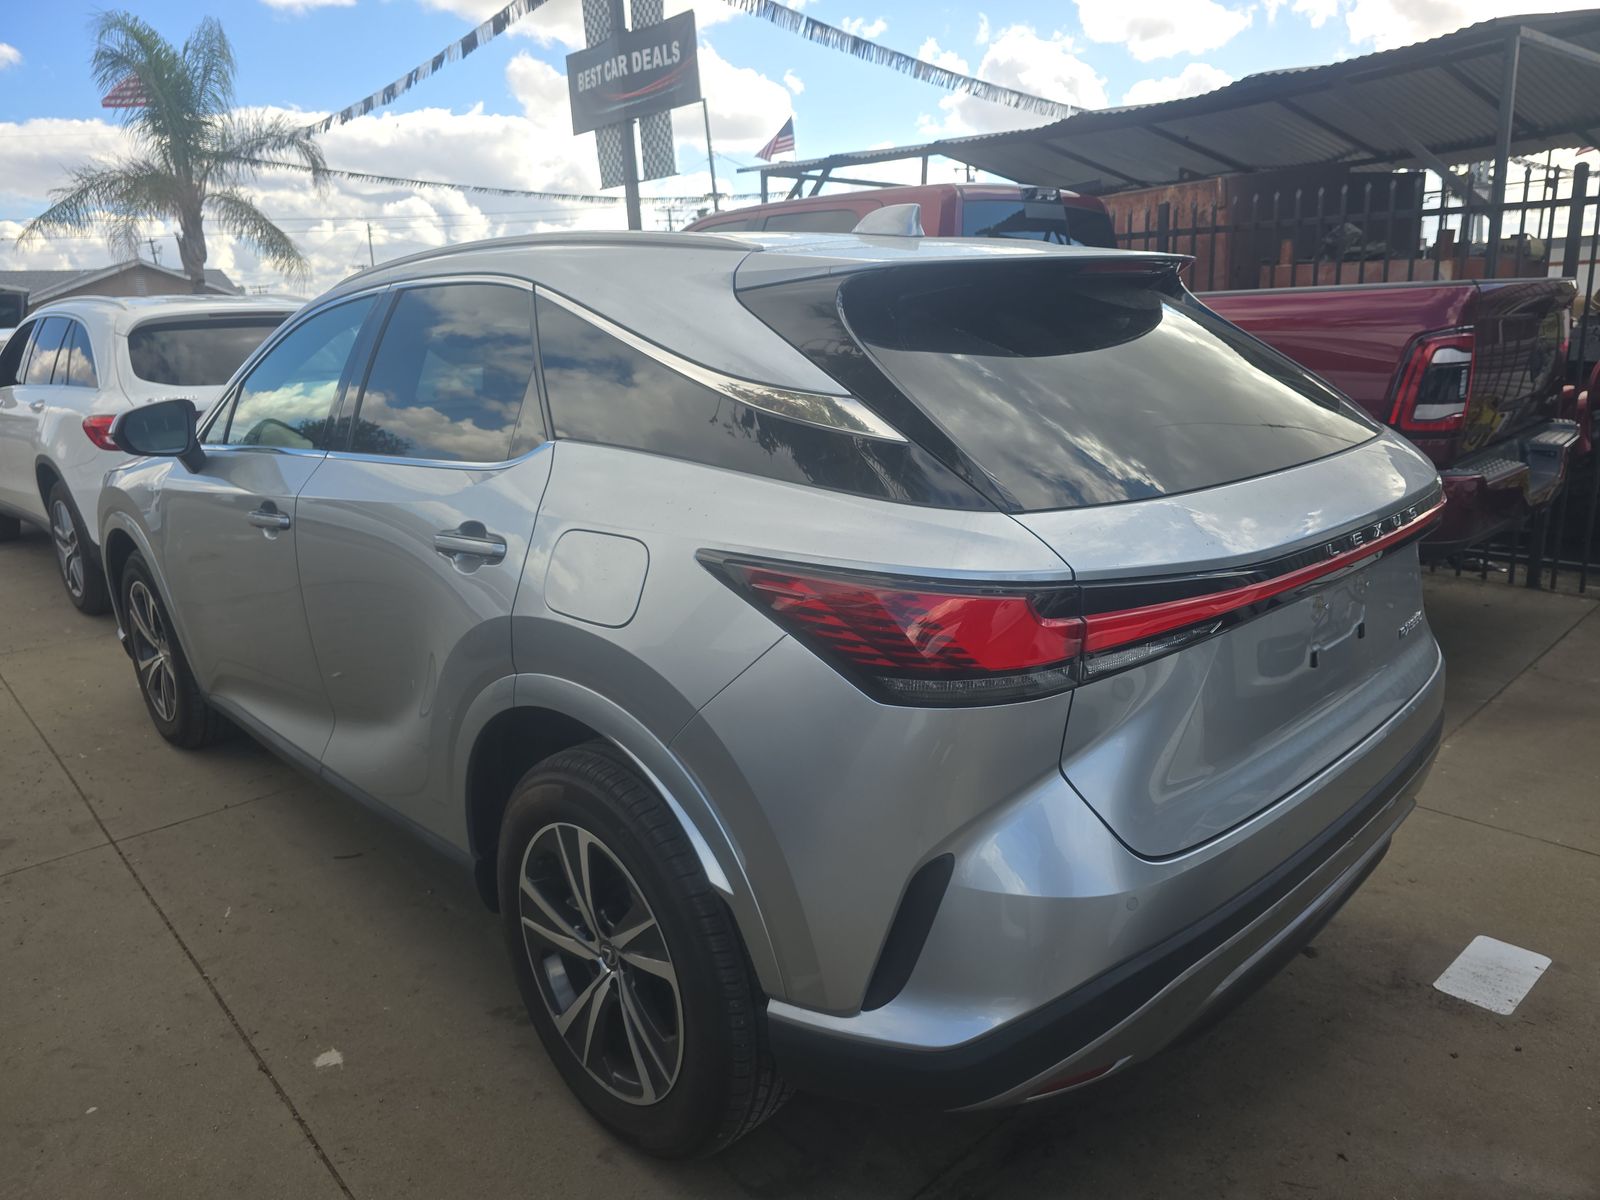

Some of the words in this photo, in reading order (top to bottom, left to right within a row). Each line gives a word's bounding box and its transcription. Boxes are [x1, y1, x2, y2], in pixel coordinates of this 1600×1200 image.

[577, 64, 602, 92] BEST
[604, 55, 628, 81] CAR
[631, 40, 681, 73] DEALS
[1325, 506, 1418, 556] LEXUS
